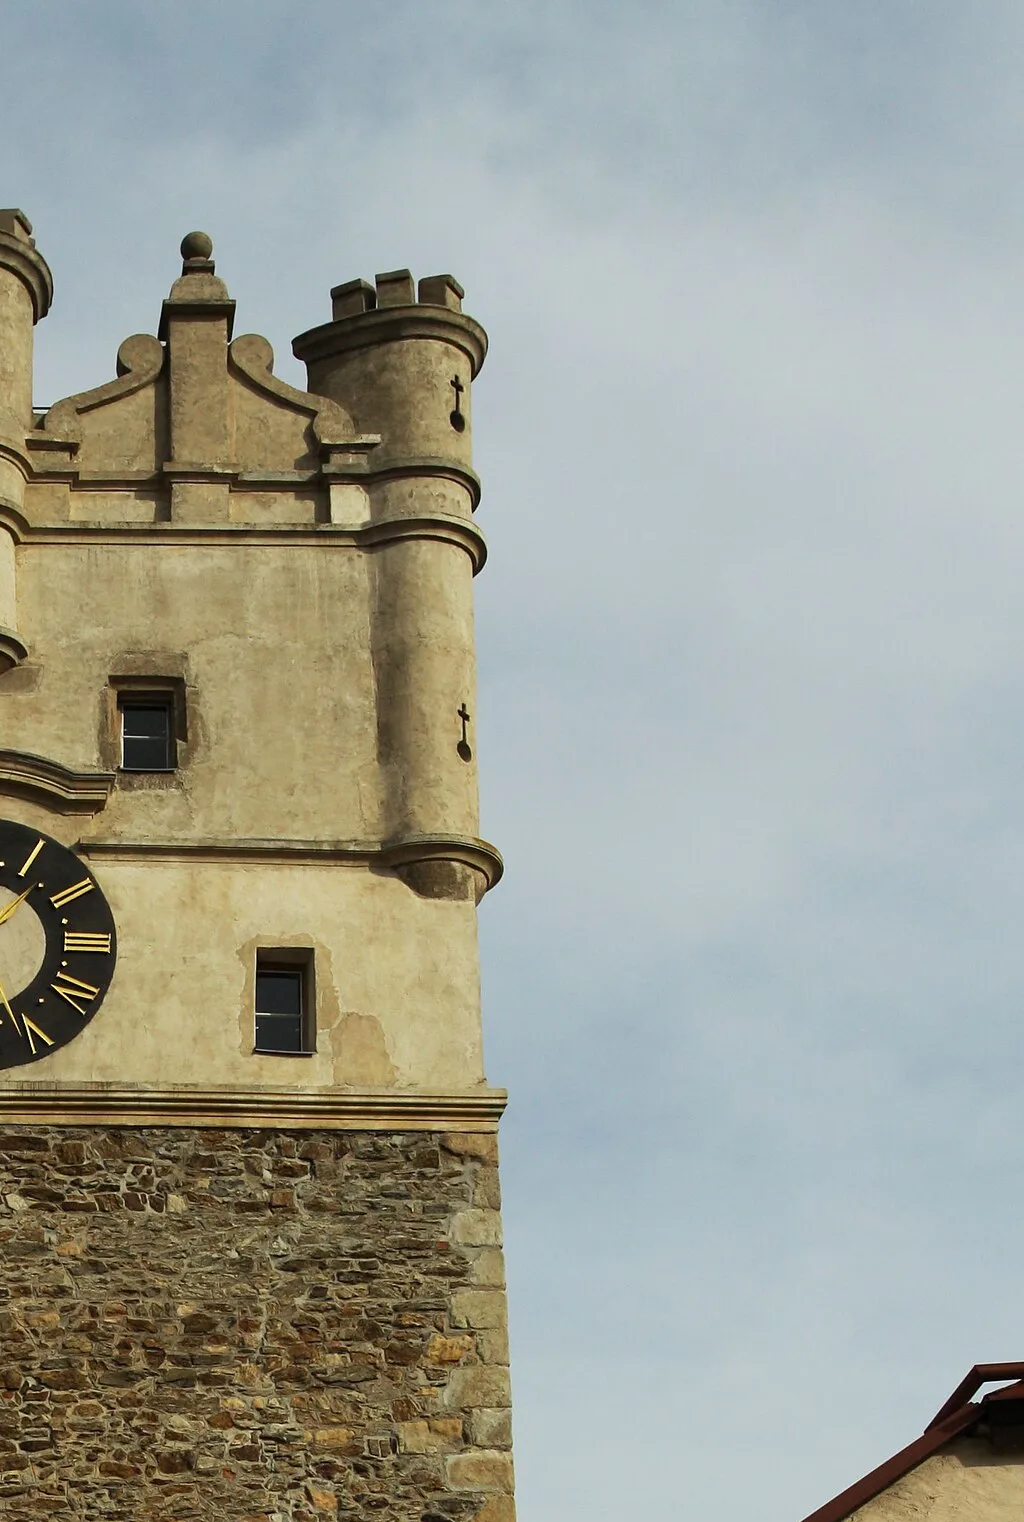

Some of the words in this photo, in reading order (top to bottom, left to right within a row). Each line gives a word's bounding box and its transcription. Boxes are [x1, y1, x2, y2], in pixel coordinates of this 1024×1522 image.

[18, 838, 46, 877] I
[49, 877, 95, 909] II
[64, 931, 111, 953] III
[50, 971, 100, 1015] IV
[21, 1013, 55, 1054] V
